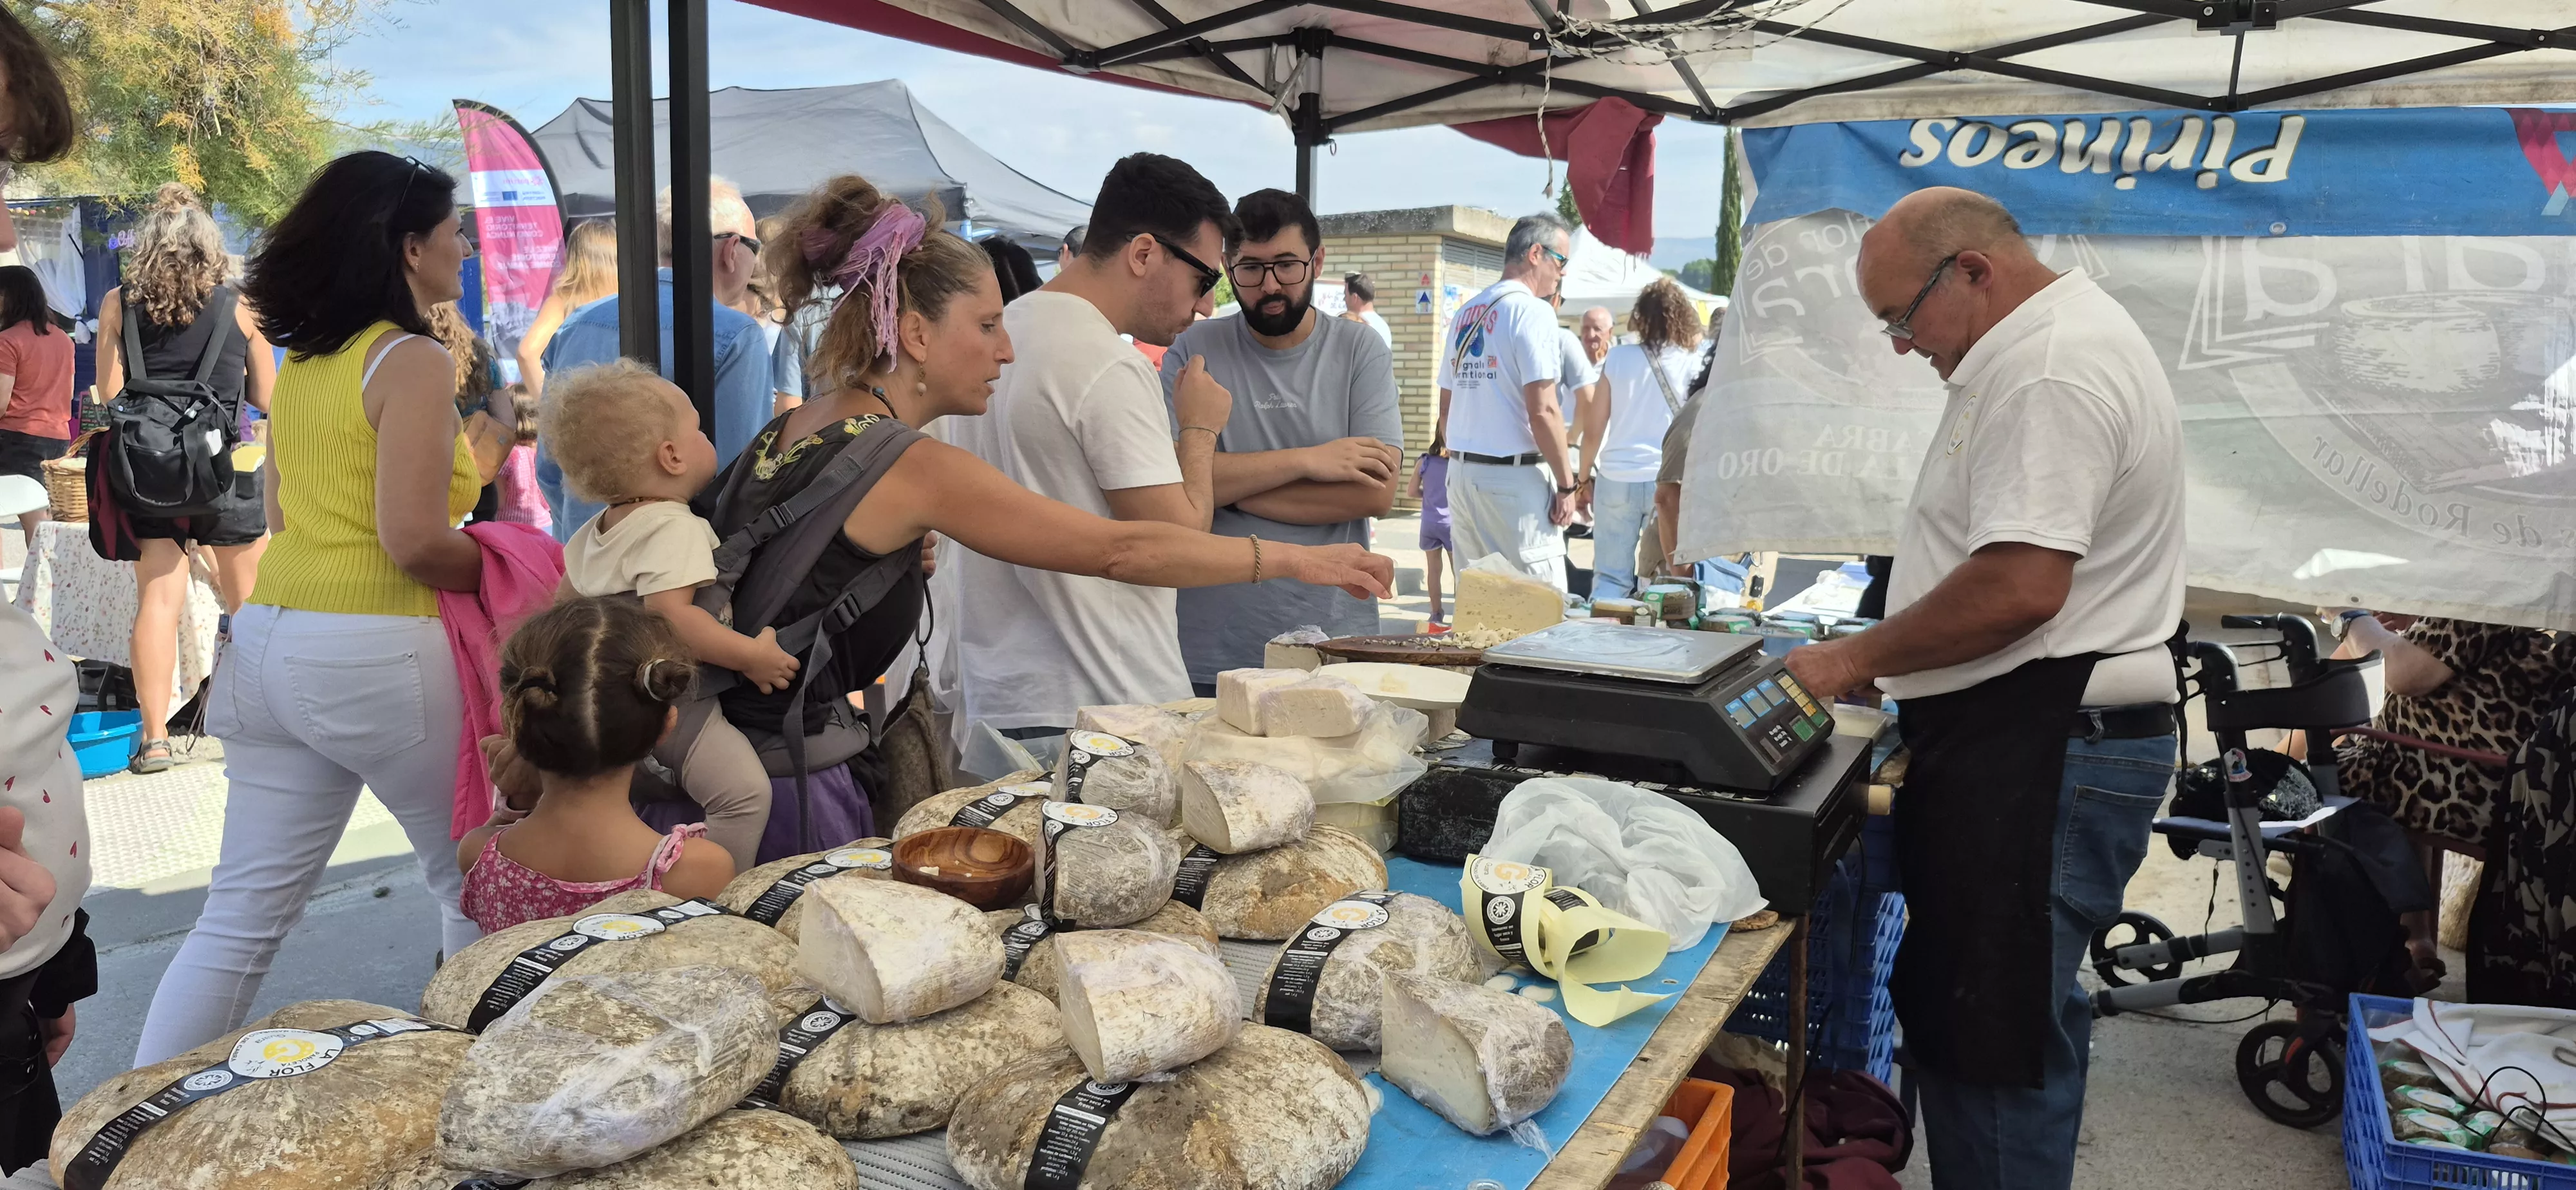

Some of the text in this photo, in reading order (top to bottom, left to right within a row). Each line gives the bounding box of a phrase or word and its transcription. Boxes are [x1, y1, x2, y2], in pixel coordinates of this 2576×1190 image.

[1899, 115, 2306, 191] Pirineos
[118, 228, 135, 246] Coff
[1358, 917, 1384, 929] FLOR
[254, 1034, 286, 1044] Guara
[230, 1044, 243, 1062] CABRA
[269, 1048, 340, 1077] LA FLOR
[1077, 1091, 1104, 1101] Mantener
[1077, 1101, 1095, 1110] fresco
